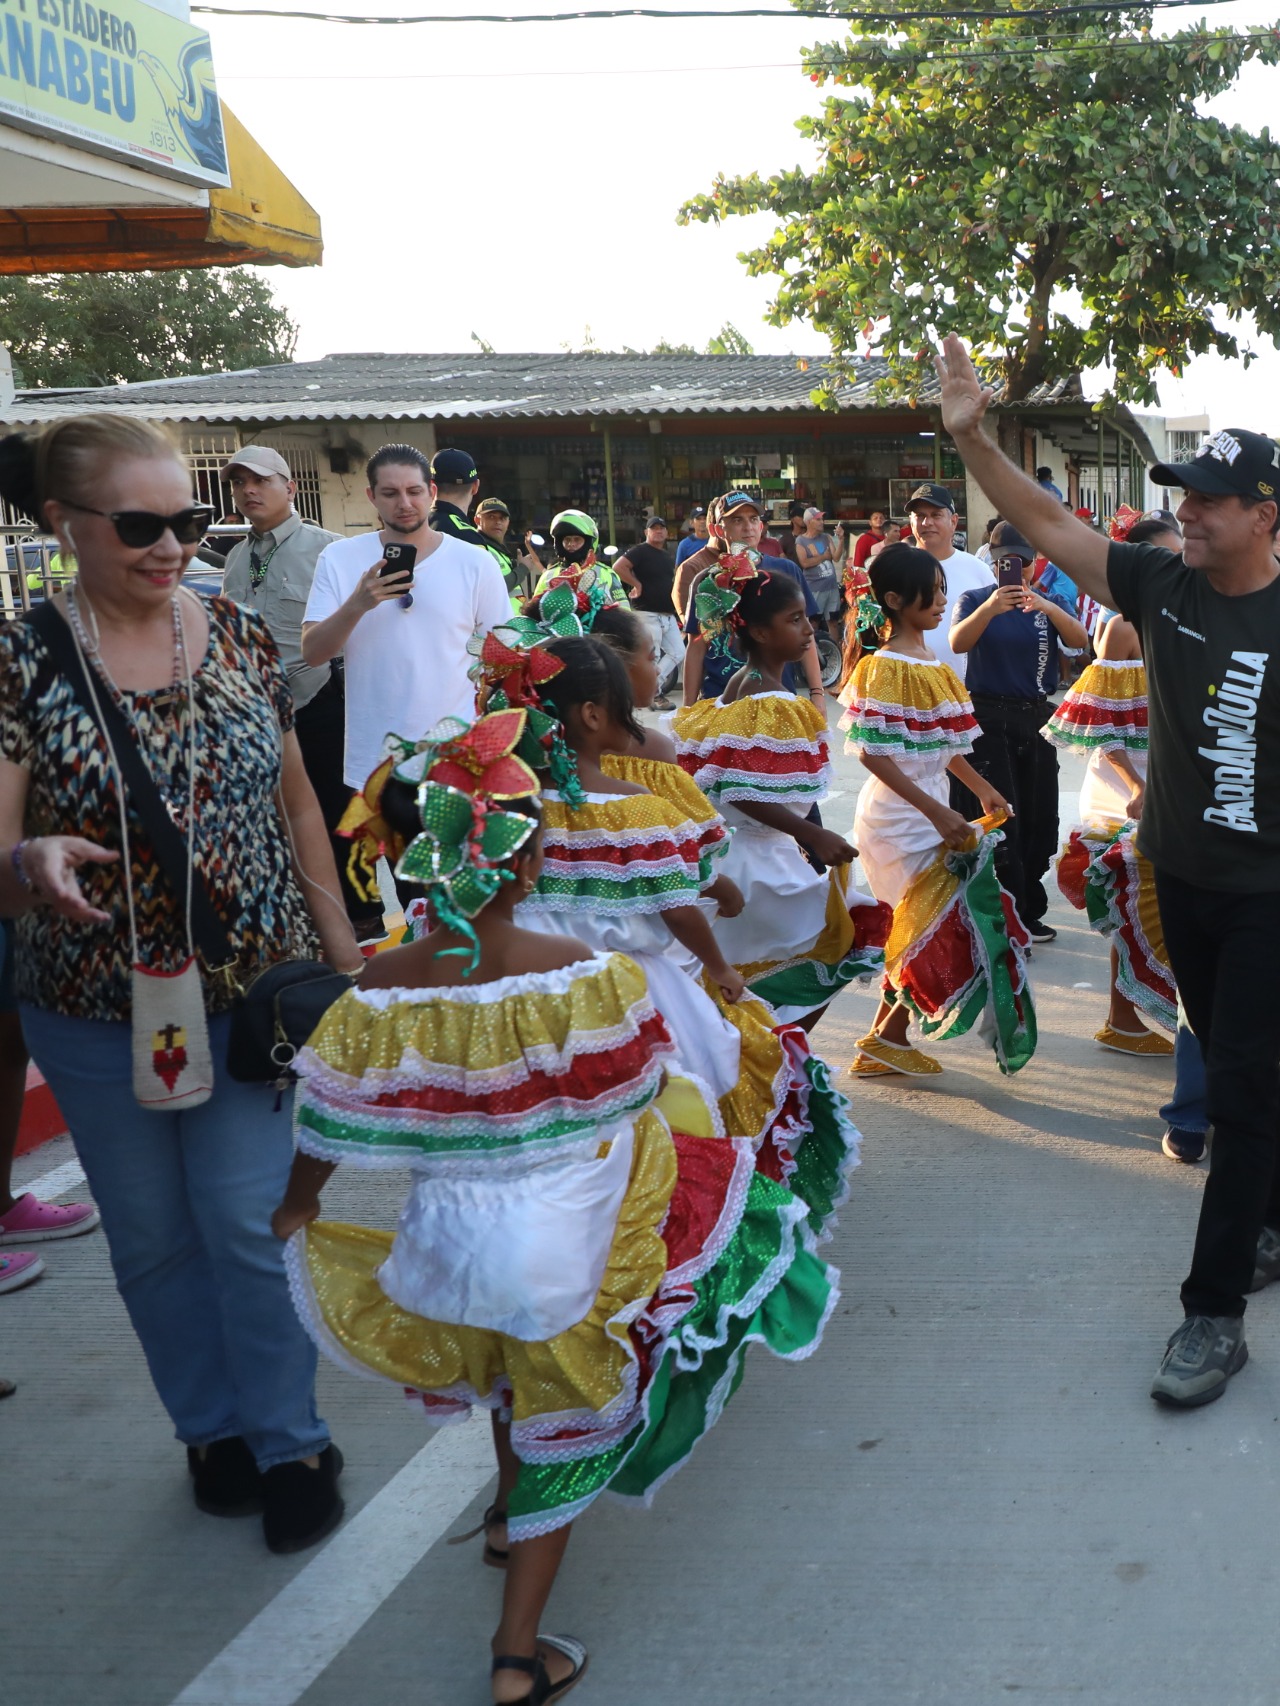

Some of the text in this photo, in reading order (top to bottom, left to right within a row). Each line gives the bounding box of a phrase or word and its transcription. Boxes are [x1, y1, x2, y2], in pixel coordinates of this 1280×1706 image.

[37, 0, 137, 59] ESTADERO
[0, 12, 136, 123] NABEU
[151, 131, 176, 152] 1913
[1036, 630, 1049, 694] ARRANQUILLA
[1198, 651, 1269, 832] BARRANQUILLA
